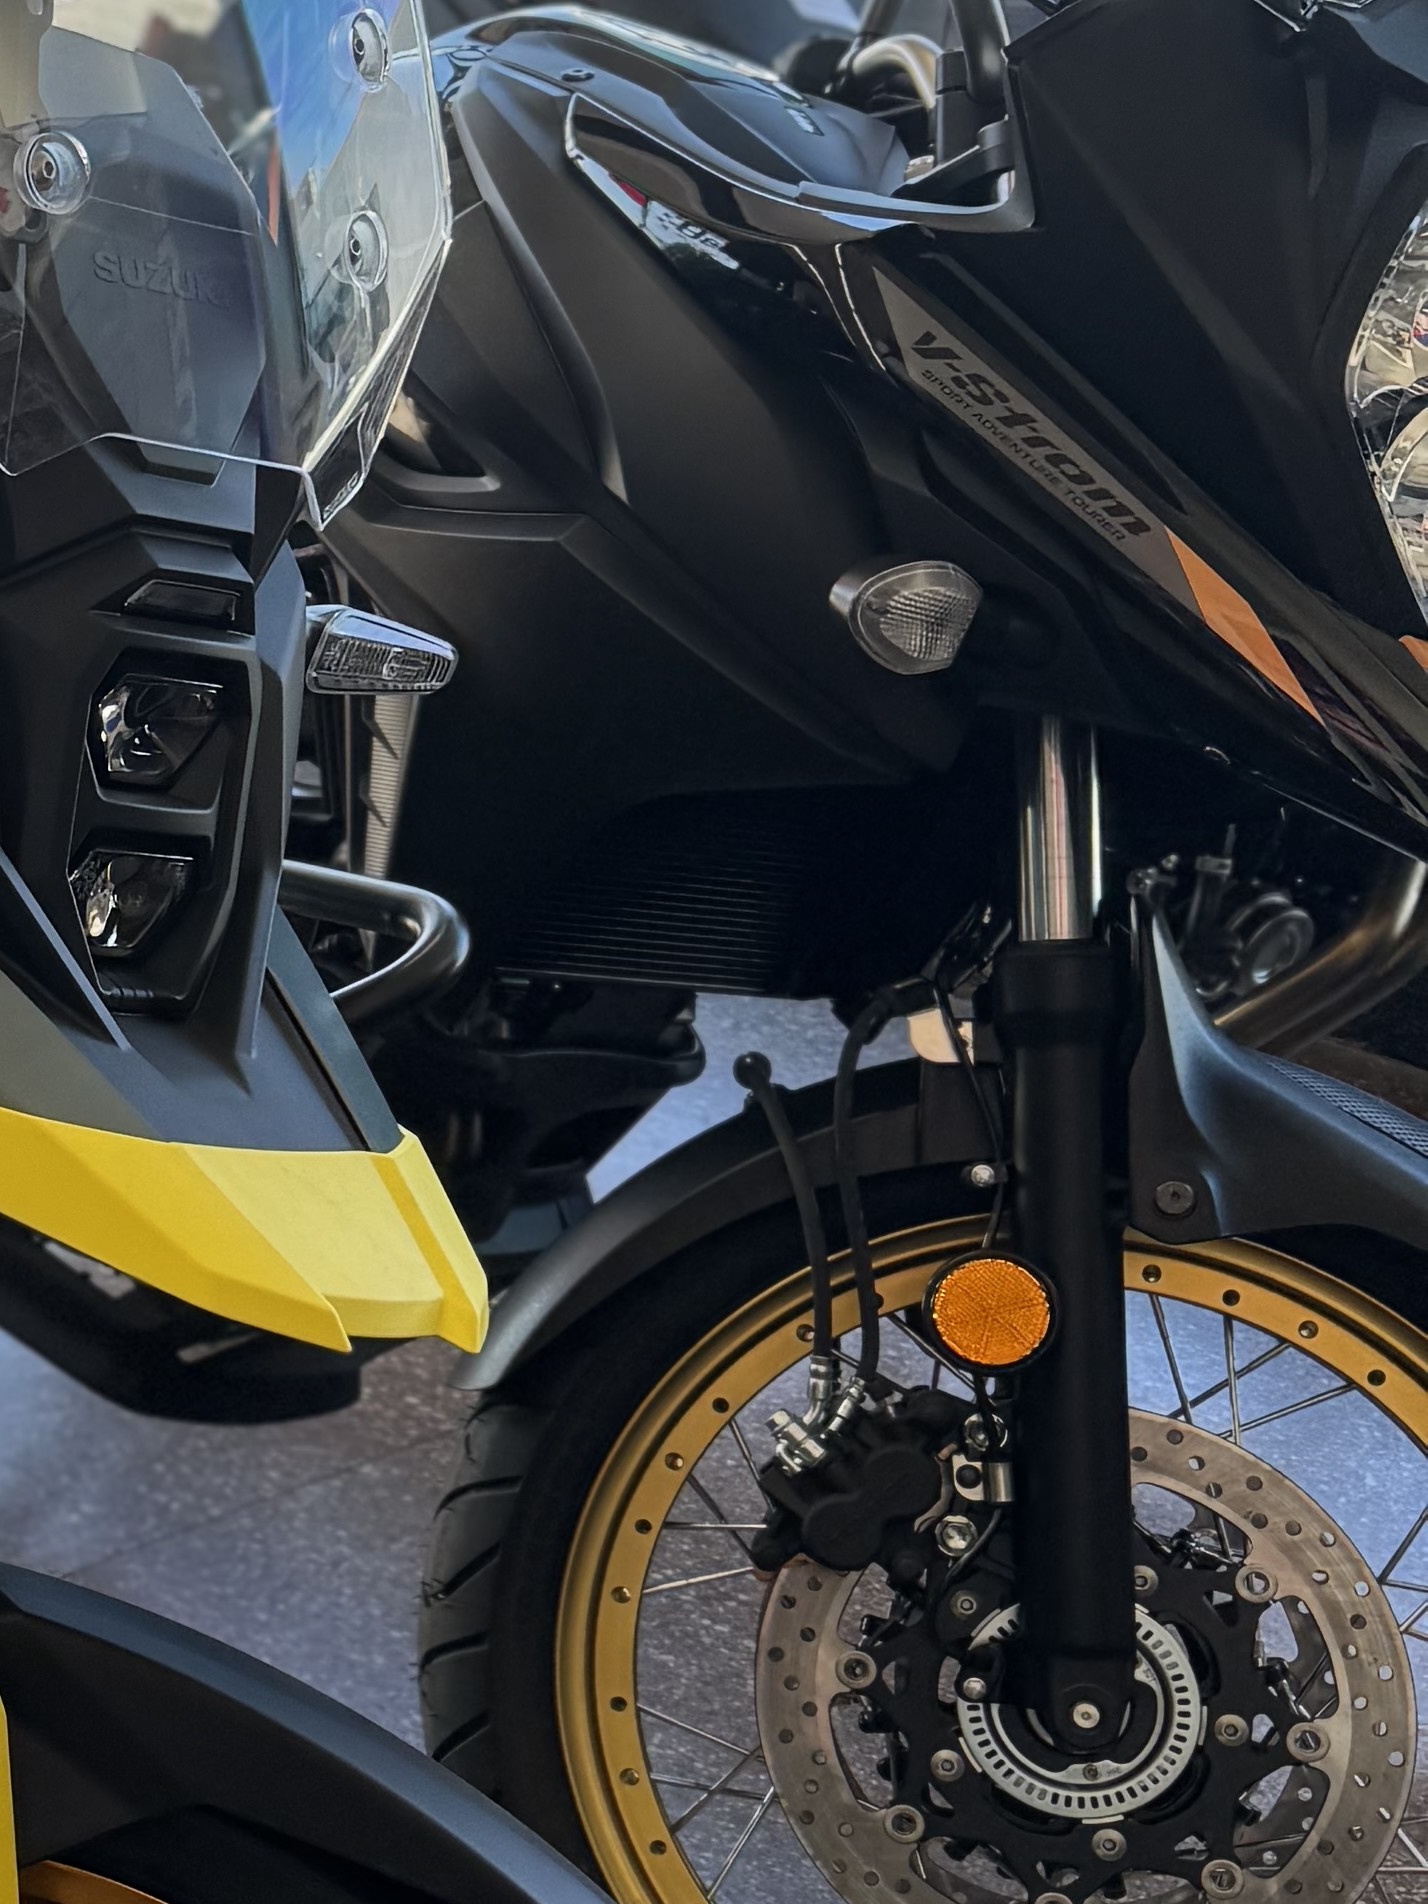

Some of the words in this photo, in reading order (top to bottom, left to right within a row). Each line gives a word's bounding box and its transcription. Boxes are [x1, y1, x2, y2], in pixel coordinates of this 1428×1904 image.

[92, 251, 231, 310] SUZUK
[921, 369, 973, 410] SPORT
[971, 412, 1065, 487] ADVENTURE
[1064, 488, 1127, 542] TOURER
